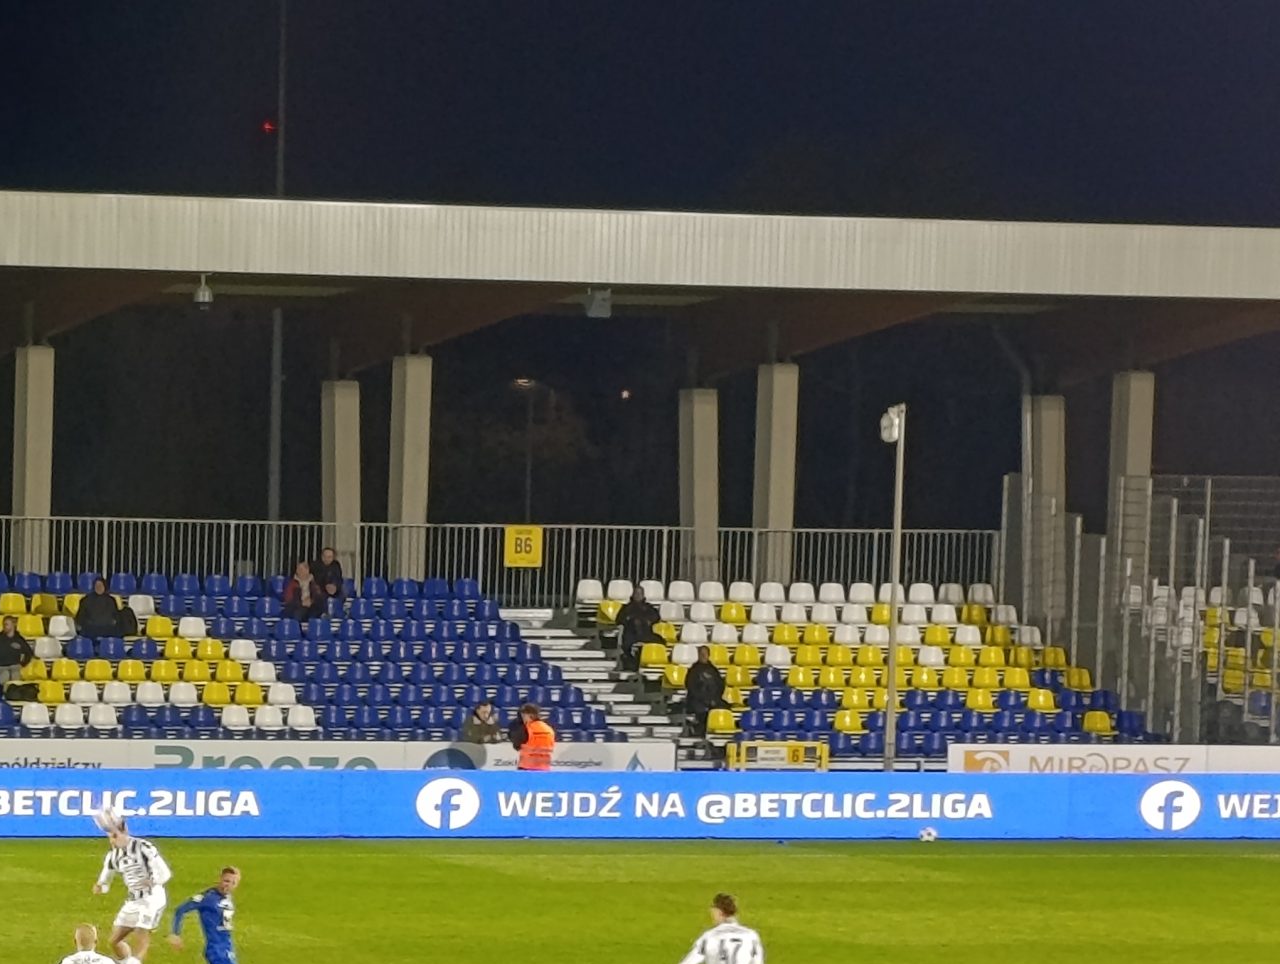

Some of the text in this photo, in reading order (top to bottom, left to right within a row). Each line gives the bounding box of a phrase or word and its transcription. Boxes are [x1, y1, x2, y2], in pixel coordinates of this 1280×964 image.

[514, 536, 533, 555] B6
[791, 744, 800, 763] 6
[498, 786, 993, 824] WEJDŹ NA @BETCLIC.2LIGA
